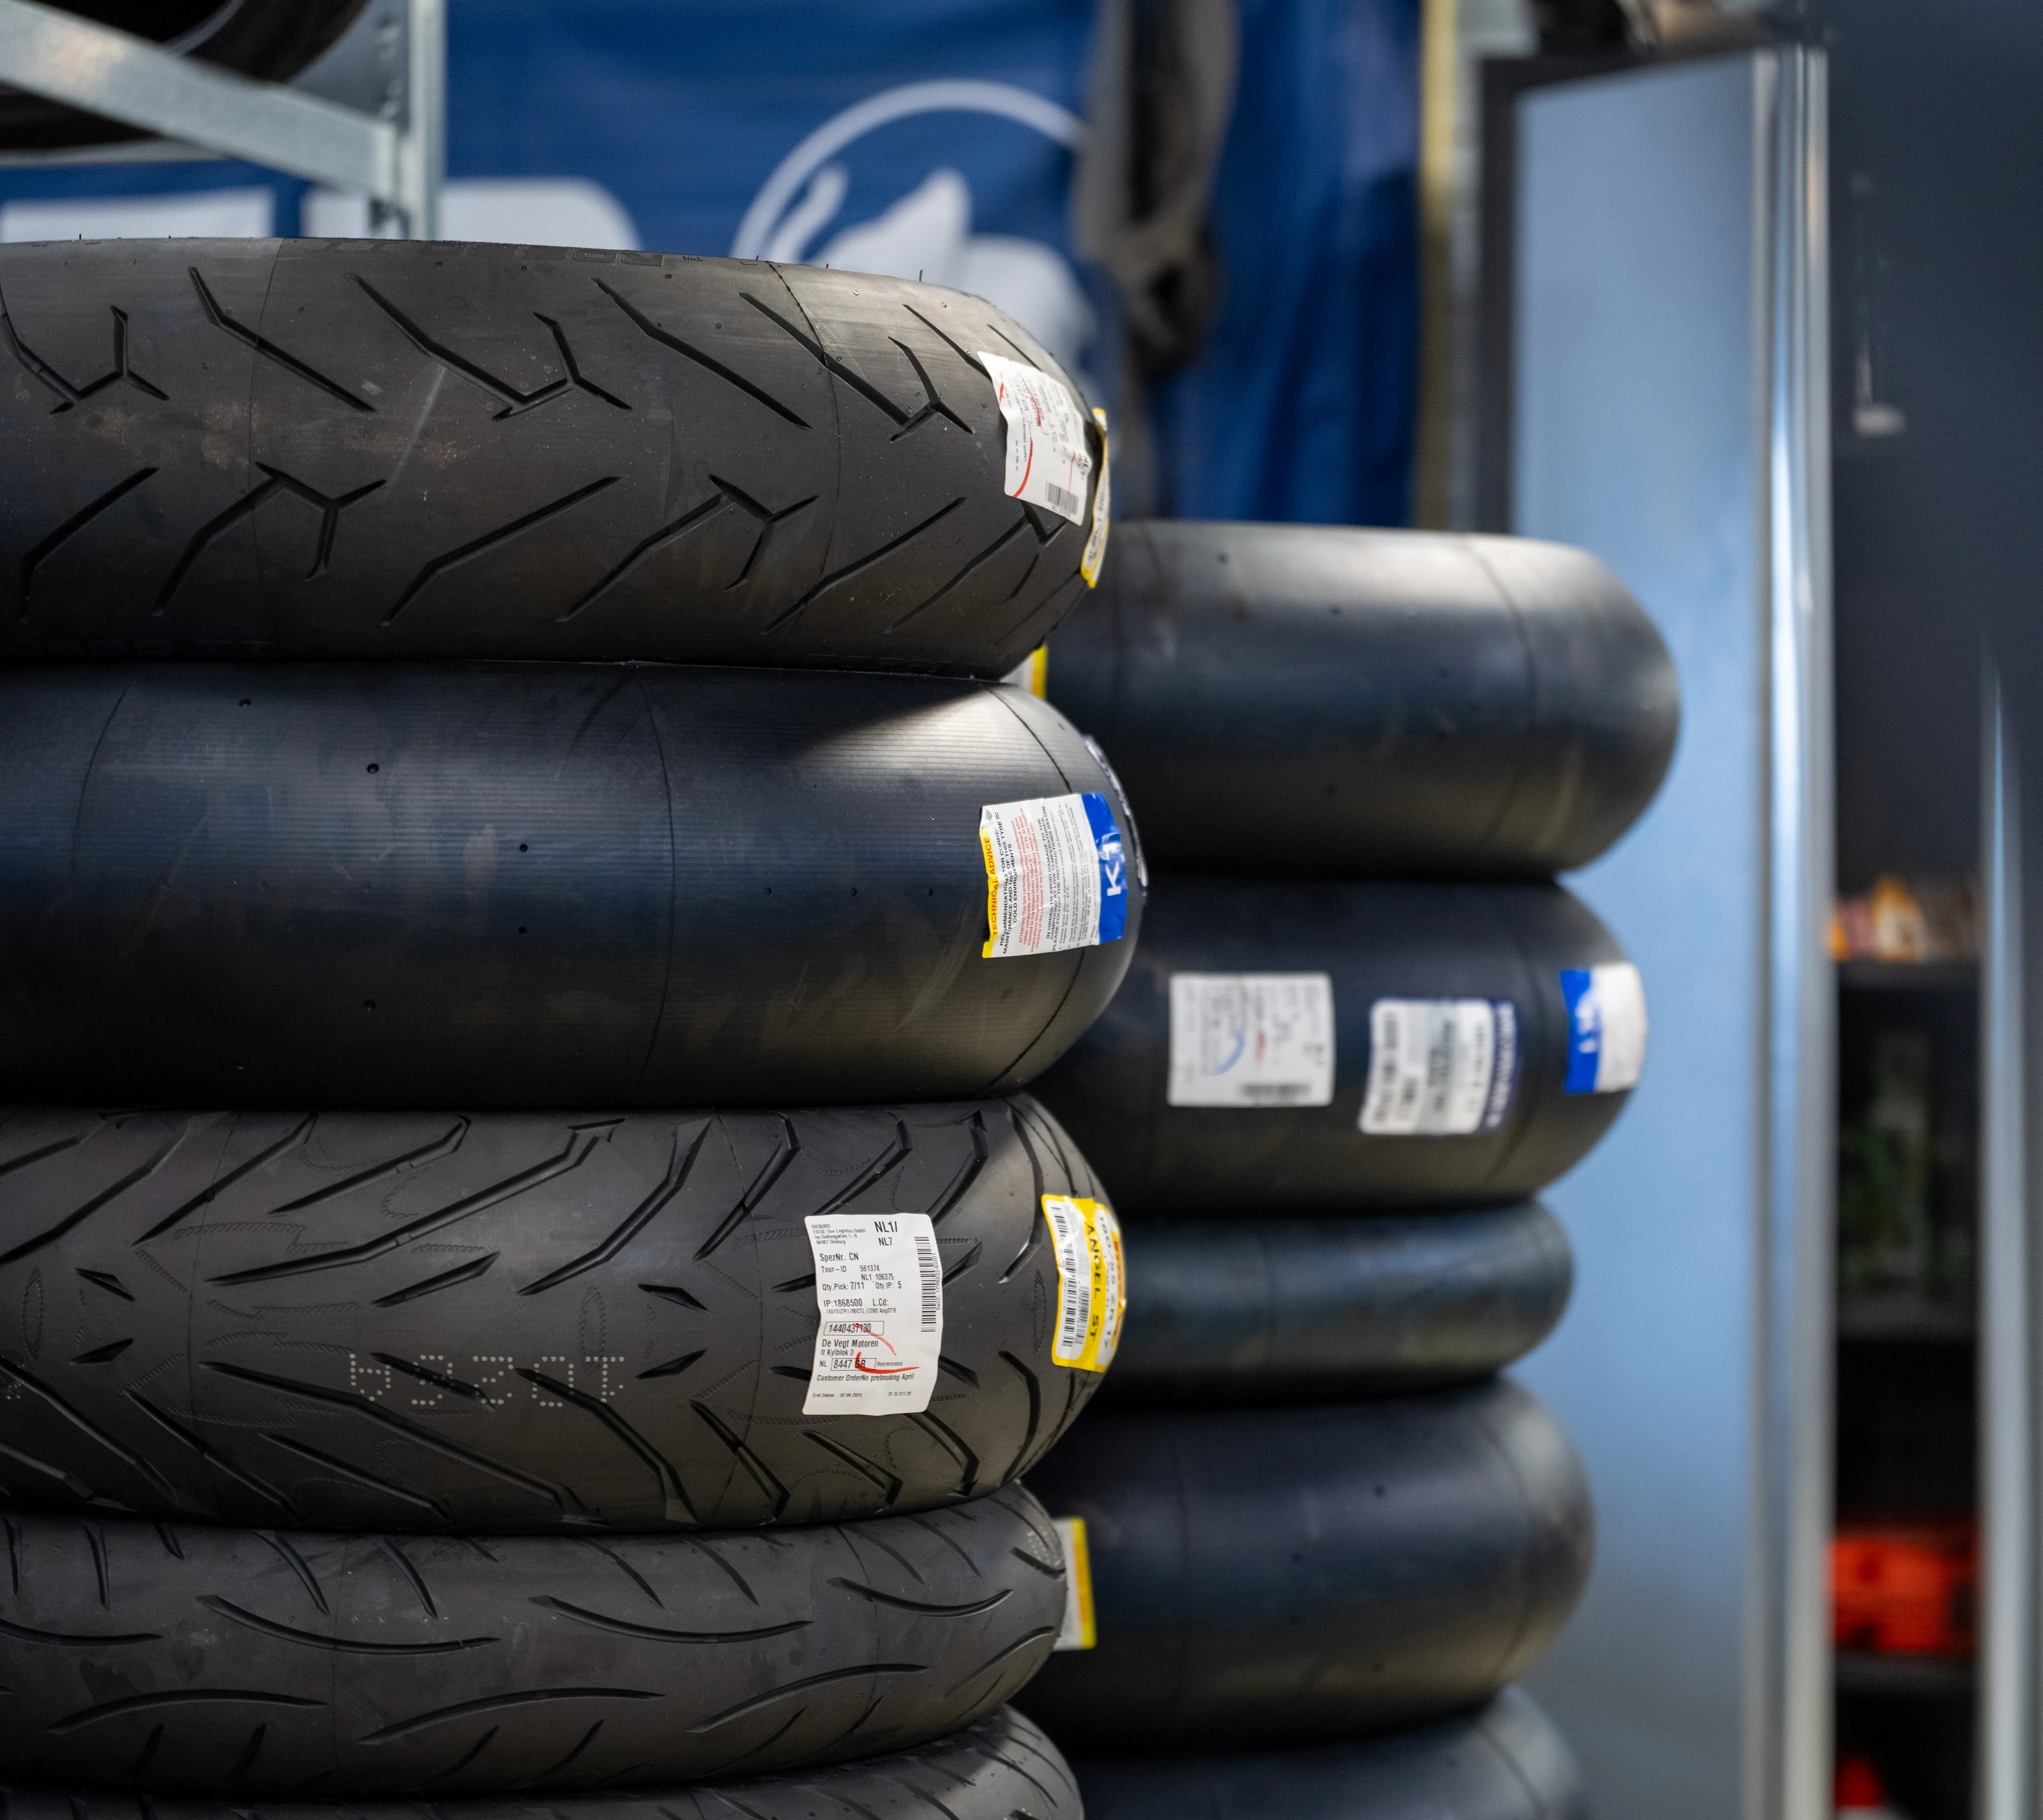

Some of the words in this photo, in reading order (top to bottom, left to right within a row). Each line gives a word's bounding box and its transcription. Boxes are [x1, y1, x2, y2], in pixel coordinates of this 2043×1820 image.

[1041, 804, 1050, 829] BELOW:
[1011, 820, 1021, 849] performance
[1041, 833, 1046, 842] TO
[984, 837, 996, 875] ADVICE
[1049, 831, 1060, 880] INSTRUCTIONS
[1005, 860, 1010, 869] OF
[1008, 844, 1018, 900] ENVIRONMENTS
[1050, 896, 1053, 906] TO
[874, 1221, 898, 1233] NL1/
[878, 1238, 892, 1246] NL7
[820, 1253, 846, 1263] SpezNr.
[1084, 1221, 1101, 1299] ANGEL
[822, 1283, 848, 1291] Qty.Pick:
[824, 1298, 862, 1308] IP:1868500
[829, 1323, 871, 1333] 1440437130
[1090, 1315, 1099, 1342] ST
[834, 1339, 849, 1348] Vegt
[852, 1339, 878, 1348] Motoren
[833, 1360, 852, 1368] 8447
[870, 1374, 900, 1382] prebooking
